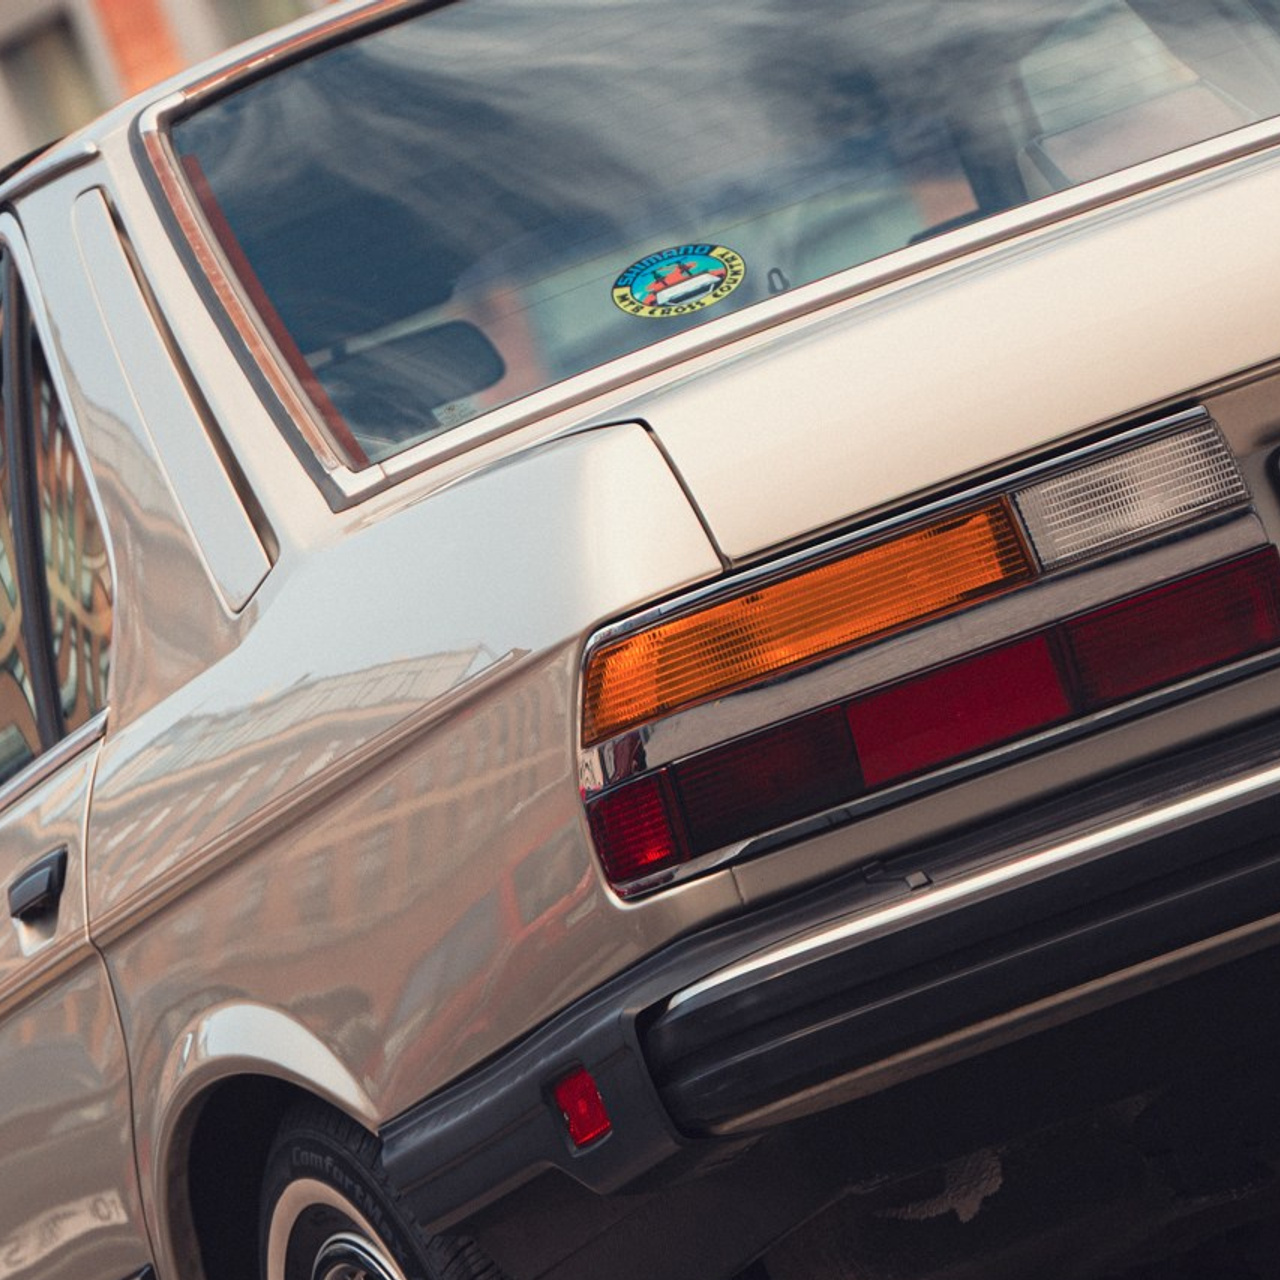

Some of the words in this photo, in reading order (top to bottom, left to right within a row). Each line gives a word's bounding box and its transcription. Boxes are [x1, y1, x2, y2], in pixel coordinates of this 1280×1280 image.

[616, 292, 644, 313] MTB
[648, 301, 707, 316] CROSS
[712, 251, 742, 299] COUNTRY
[617, 244, 711, 286] SHIMANO
